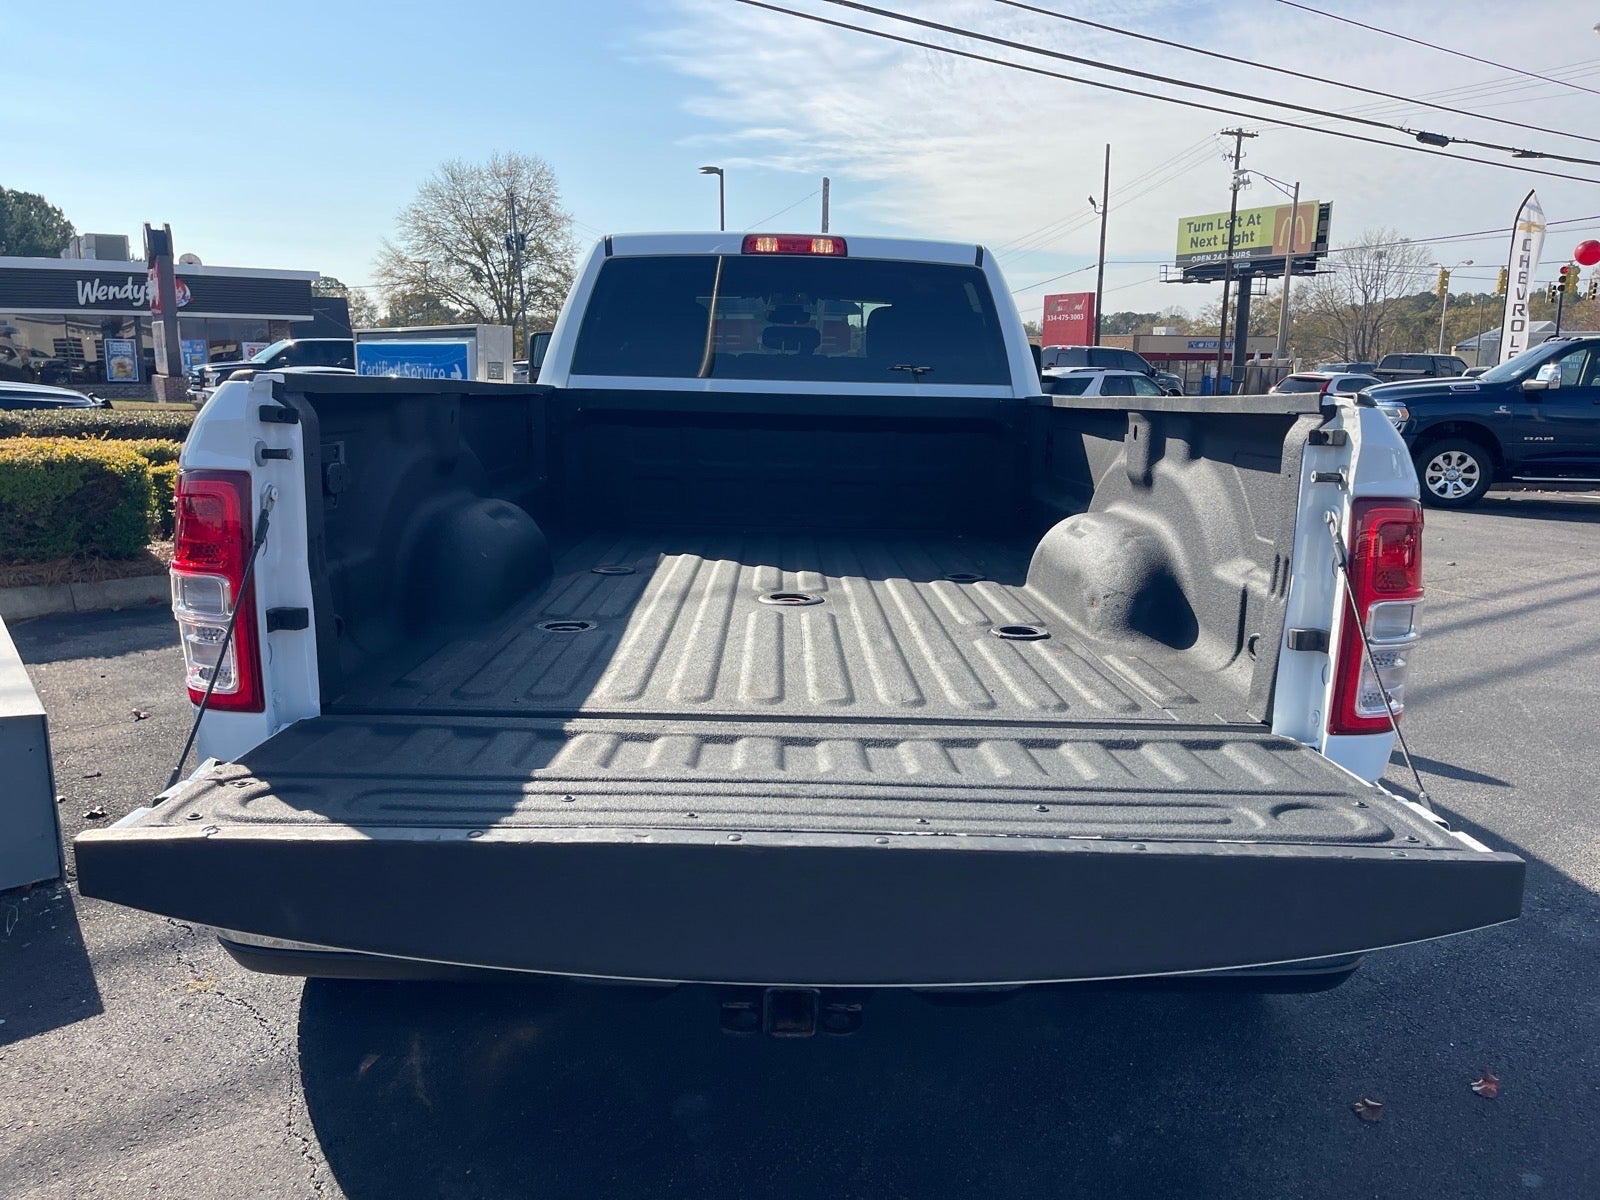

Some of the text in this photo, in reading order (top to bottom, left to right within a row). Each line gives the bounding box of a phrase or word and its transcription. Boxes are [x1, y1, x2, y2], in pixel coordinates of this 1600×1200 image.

[1187, 221, 1213, 234] Turn
[1246, 213, 1262, 227] At
[1190, 230, 1255, 249] Next Lght
[1191, 254, 1211, 263] OPEN
[1212, 253, 1223, 261] 24
